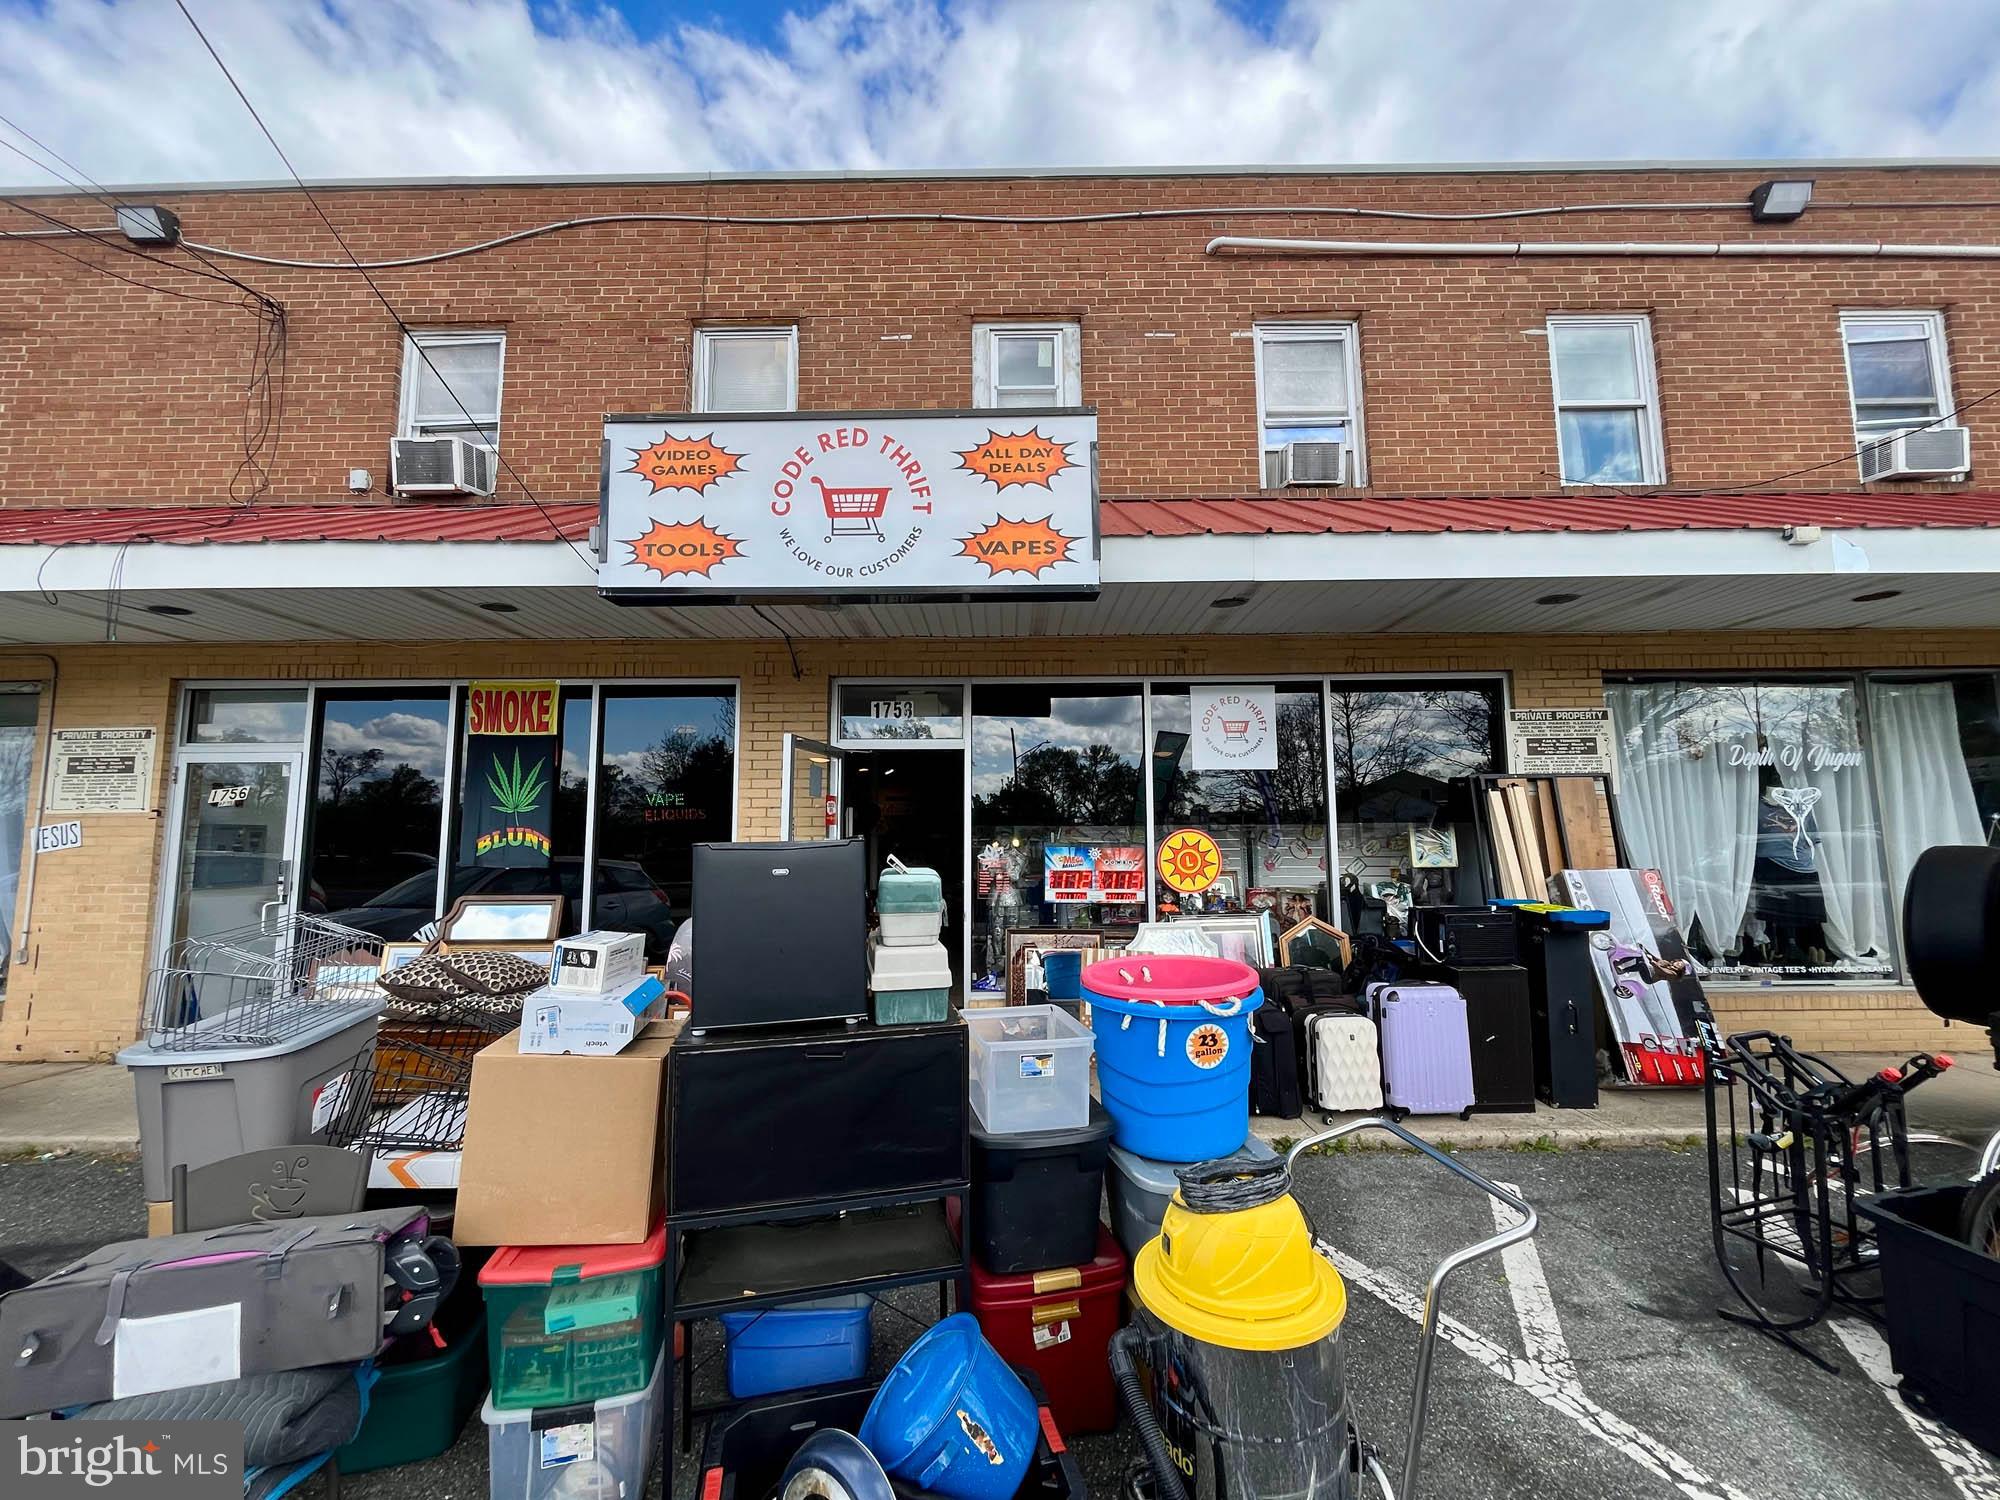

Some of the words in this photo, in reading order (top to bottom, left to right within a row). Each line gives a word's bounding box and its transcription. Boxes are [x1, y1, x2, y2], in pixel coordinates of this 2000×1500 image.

[653, 450, 711, 461] VIDEO
[981, 448, 1013, 459] ALL
[1020, 447, 1054, 458] DAY
[651, 464, 717, 476] GAMES
[771, 446, 814, 516] CODE
[817, 427, 869, 453] RED
[879, 434, 932, 515] THRIFT
[989, 462, 1046, 473] DEALS
[643, 543, 725, 557] TOOLS
[779, 528, 796, 548] WE
[792, 546, 822, 571] LOVE
[825, 565, 854, 578] OUR
[859, 526, 923, 577] CUSTOMERS
[976, 540, 1057, 556] VAPES
[470, 689, 552, 734] SMOKE
[1202, 703, 1218, 733] CODE
[1219, 696, 1240, 707] RED
[1244, 699, 1268, 733] THRIFT
[1515, 711, 1553, 721] PRIVATE
[1556, 711, 1604, 720] PROPERTY
[61, 731, 98, 740] PRIVATE
[101, 730, 147, 739] PROPERTY
[1728, 744, 1775, 771] Depth
[1780, 744, 1804, 771] Of
[1807, 744, 1863, 772] Yugen
[211, 787, 248, 802] 1756
[645, 793, 685, 806] VAPE
[645, 808, 707, 822] ELIQUIDS
[1649, 883, 1671, 922] Razor
[1710, 966, 1744, 974] JEWELRY
[1751, 966, 1783, 974] VINTAGE
[1198, 1033, 1219, 1048] 23
[1195, 1047, 1223, 1059] gallon
[170, 1064, 221, 1078] KITCHEN
